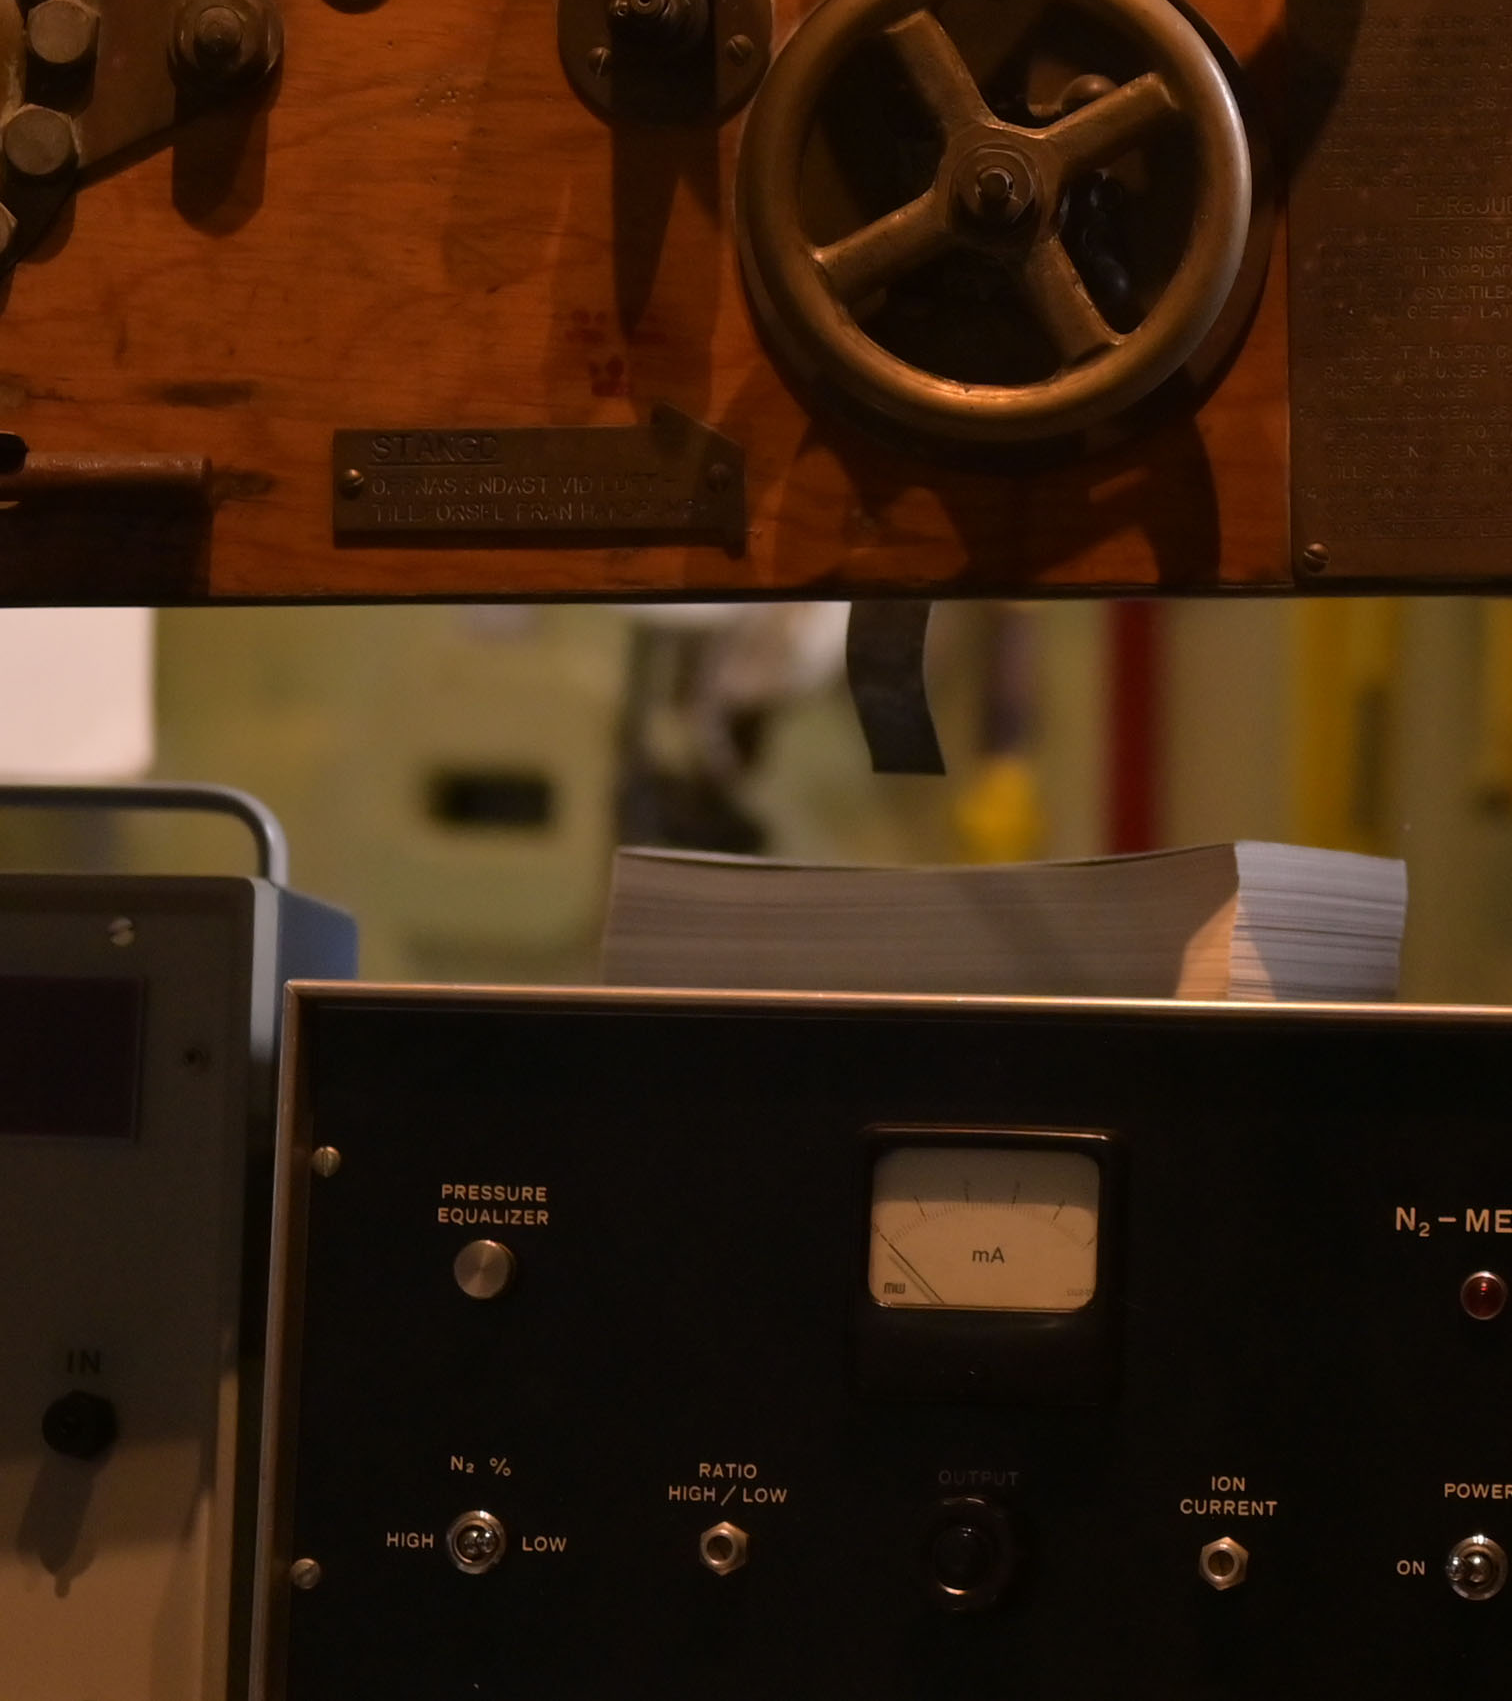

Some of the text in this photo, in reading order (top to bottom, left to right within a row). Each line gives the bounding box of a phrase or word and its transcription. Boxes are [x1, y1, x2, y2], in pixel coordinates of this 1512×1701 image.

[441, 1183, 547, 1203] PRESSURE
[437, 1207, 549, 1226] EQUALIZER
[971, 1246, 1006, 1265] mA
[67, 1350, 101, 1375] IN
[699, 1462, 758, 1480] RATIO
[937, 1469, 1019, 1487] OUTPUT
[1211, 1475, 1246, 1492] ION
[1179, 1498, 1278, 1517] CURRENT
[386, 1531, 567, 1552] HIGH LOW
[1396, 1559, 1425, 1576] ON
